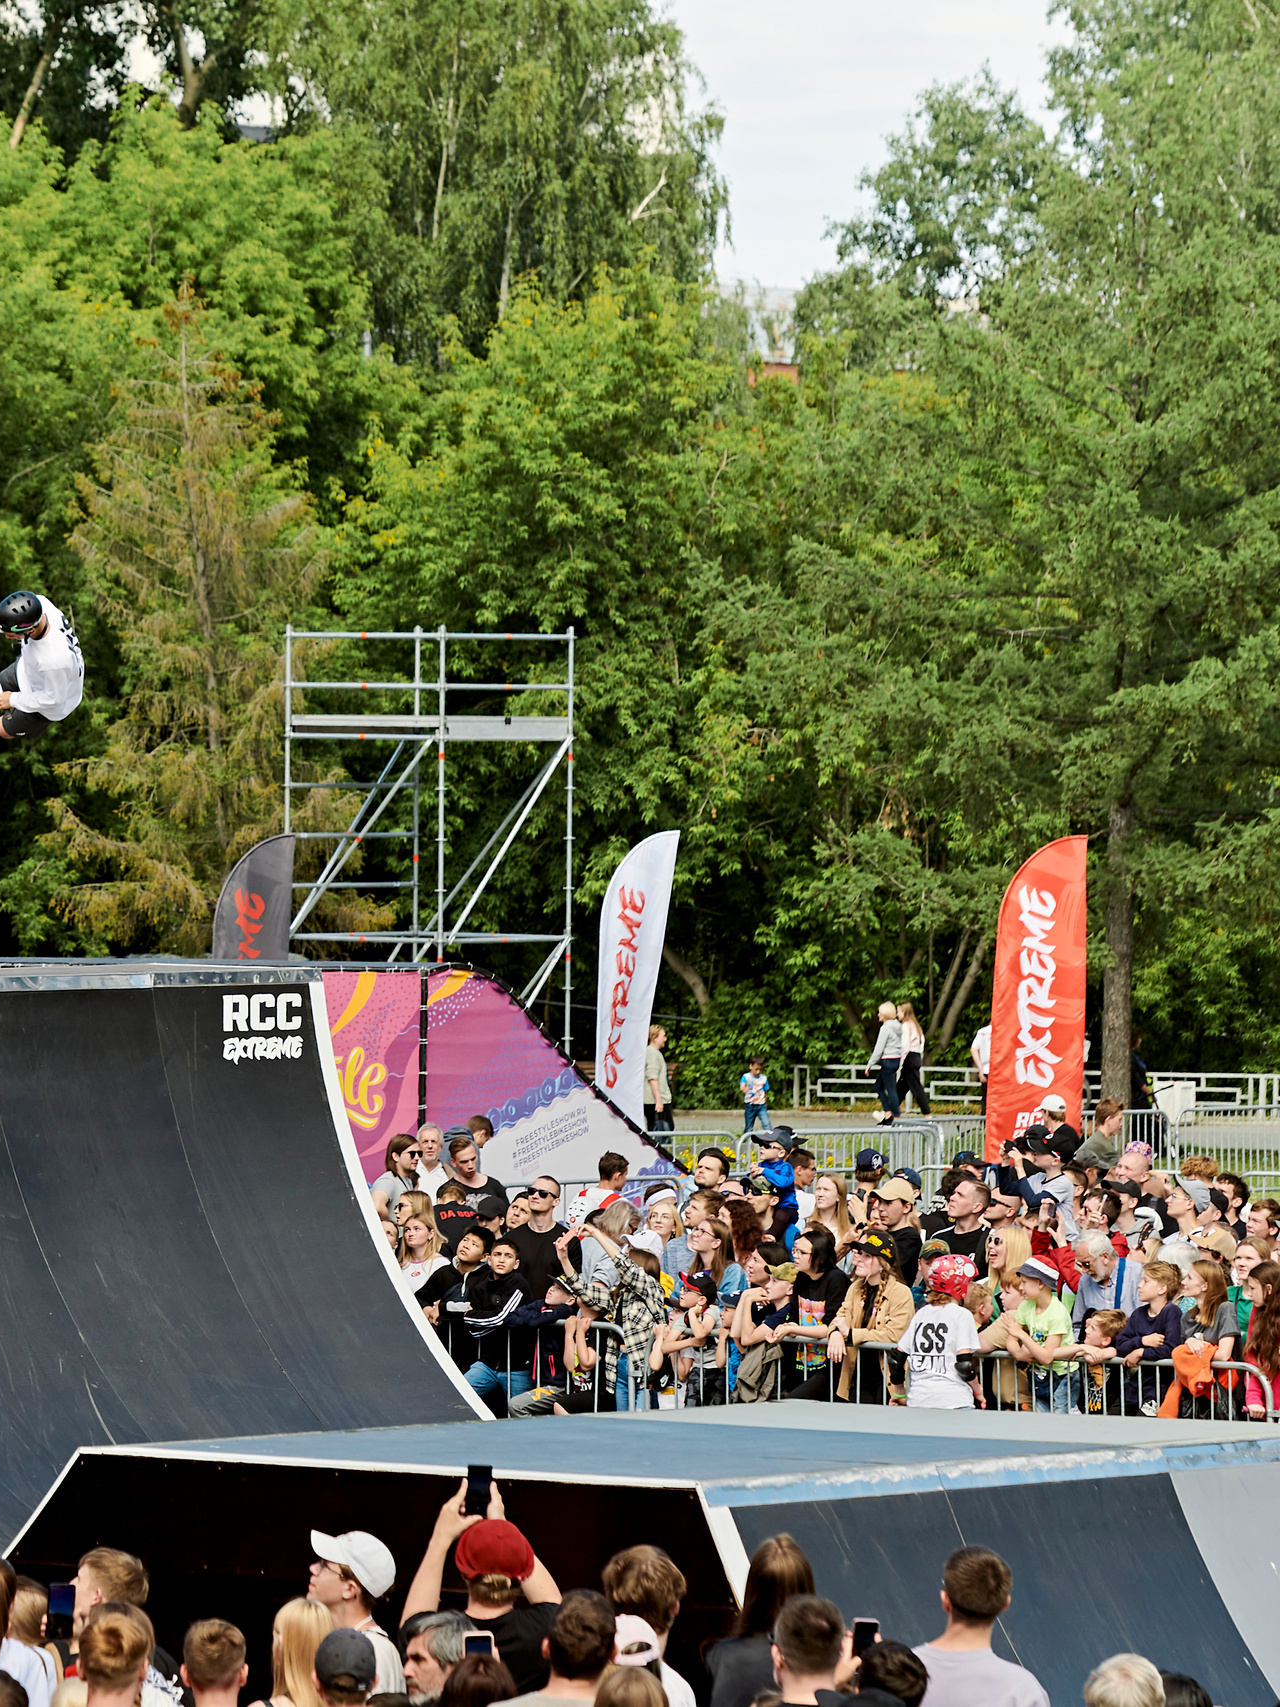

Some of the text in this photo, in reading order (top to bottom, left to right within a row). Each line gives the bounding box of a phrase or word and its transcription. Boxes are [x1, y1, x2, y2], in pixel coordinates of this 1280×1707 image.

[603, 884, 645, 1089] EXTREME
[1015, 884, 1063, 1088] EXTREME
[222, 993, 302, 1031] RCC
[222, 1035, 303, 1065] EXTREME
[515, 1106, 587, 1147] FREESTYLESHOW.RU
[1015, 1112, 1045, 1128] RC
